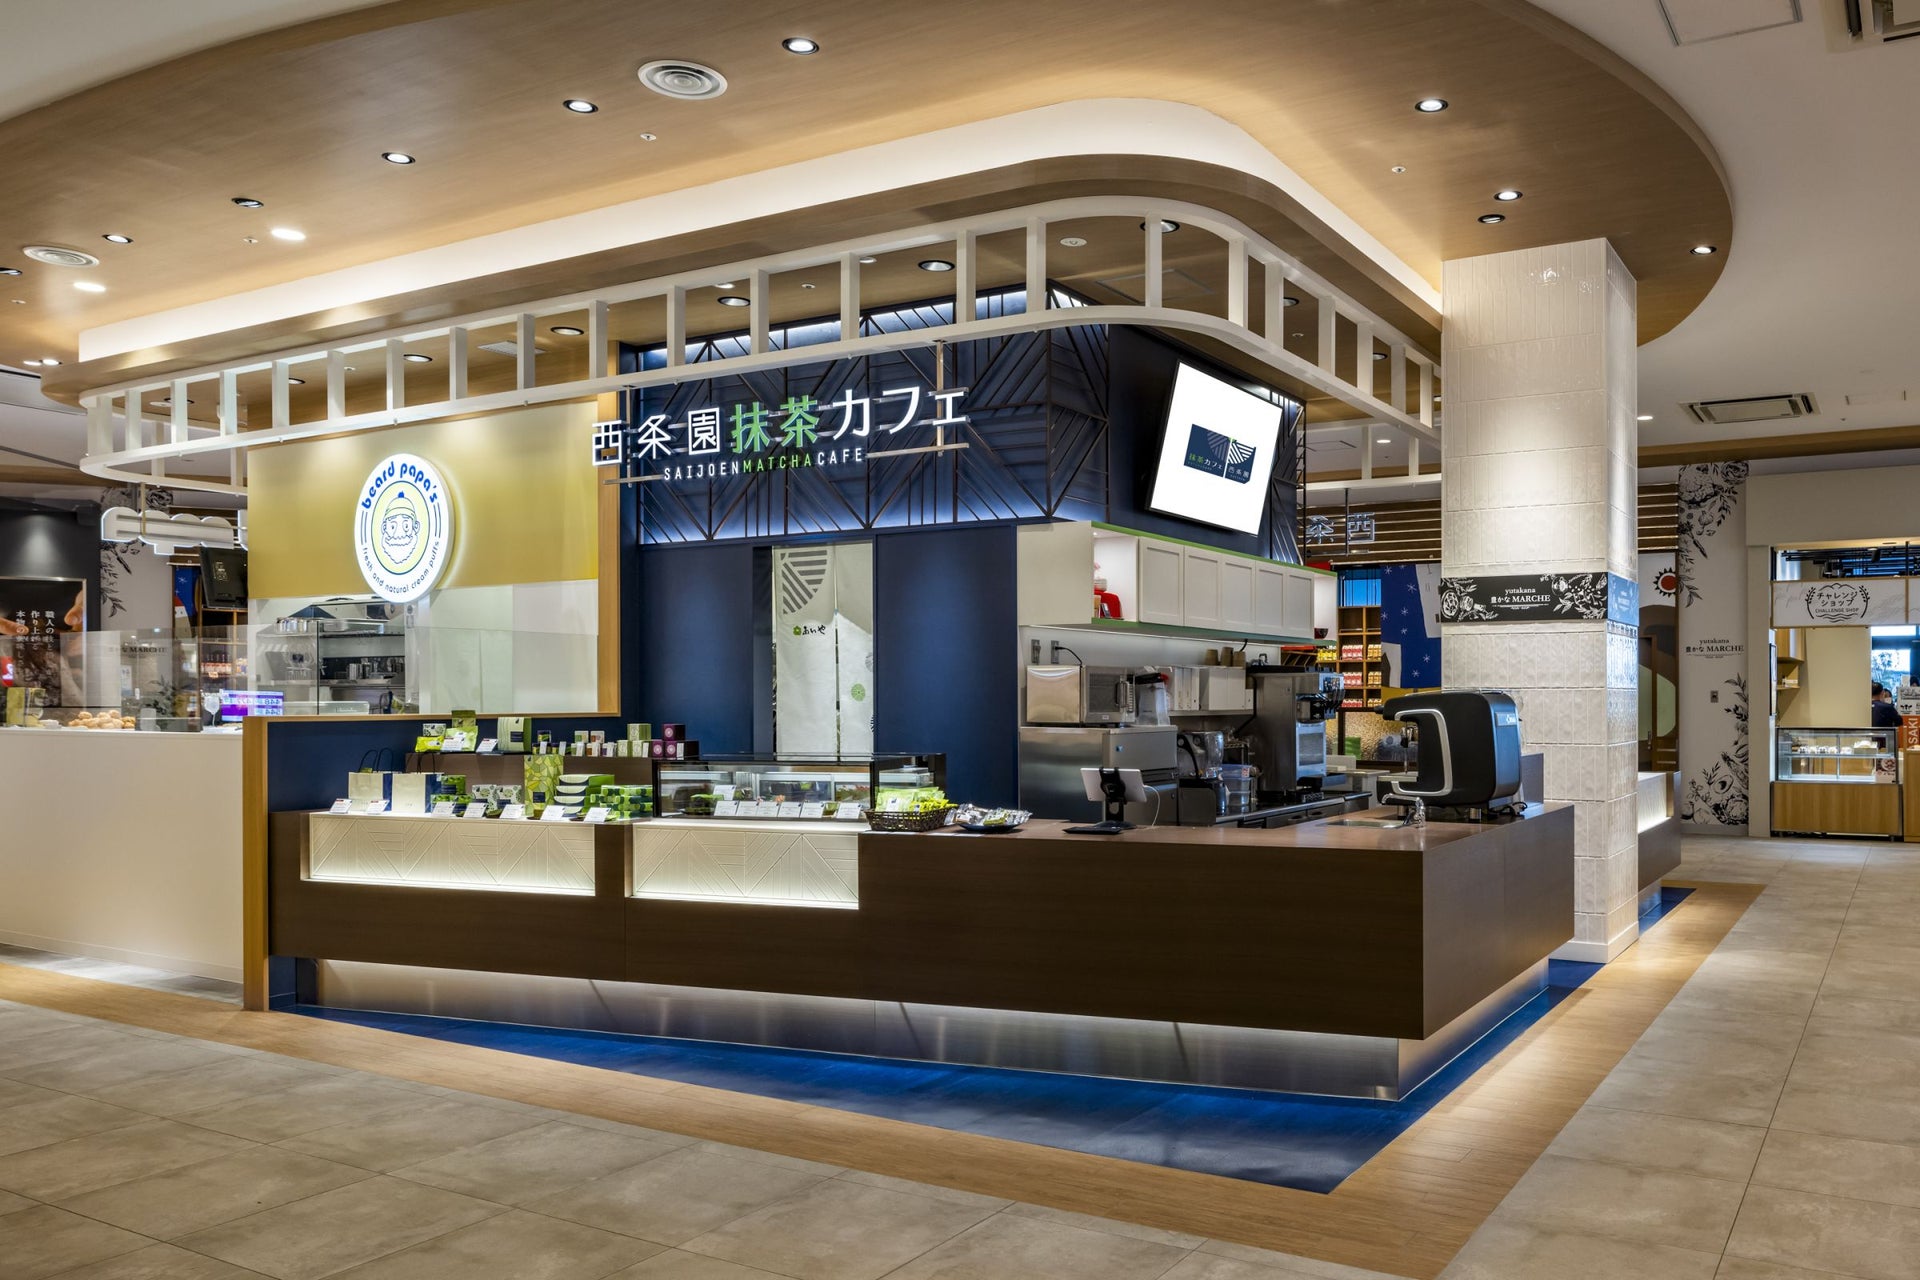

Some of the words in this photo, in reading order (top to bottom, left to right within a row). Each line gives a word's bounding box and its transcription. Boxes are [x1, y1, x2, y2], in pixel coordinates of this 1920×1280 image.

[361, 461, 395, 509] beard
[400, 463, 438, 503] papa's
[363, 547, 373, 571] fresh
[372, 572, 385, 586] and
[384, 584, 409, 594] natural
[411, 568, 430, 589] cream
[428, 541, 440, 568] puffs
[1504, 587, 1536, 595] yutakana
[1816, 591, 1858, 600] チャレンジ
[1512, 594, 1551, 603] MARCHE
[1820, 598, 1855, 607] ショップ
[802, 624, 827, 636] あいや
[1706, 644, 1744, 652] MARCHE
